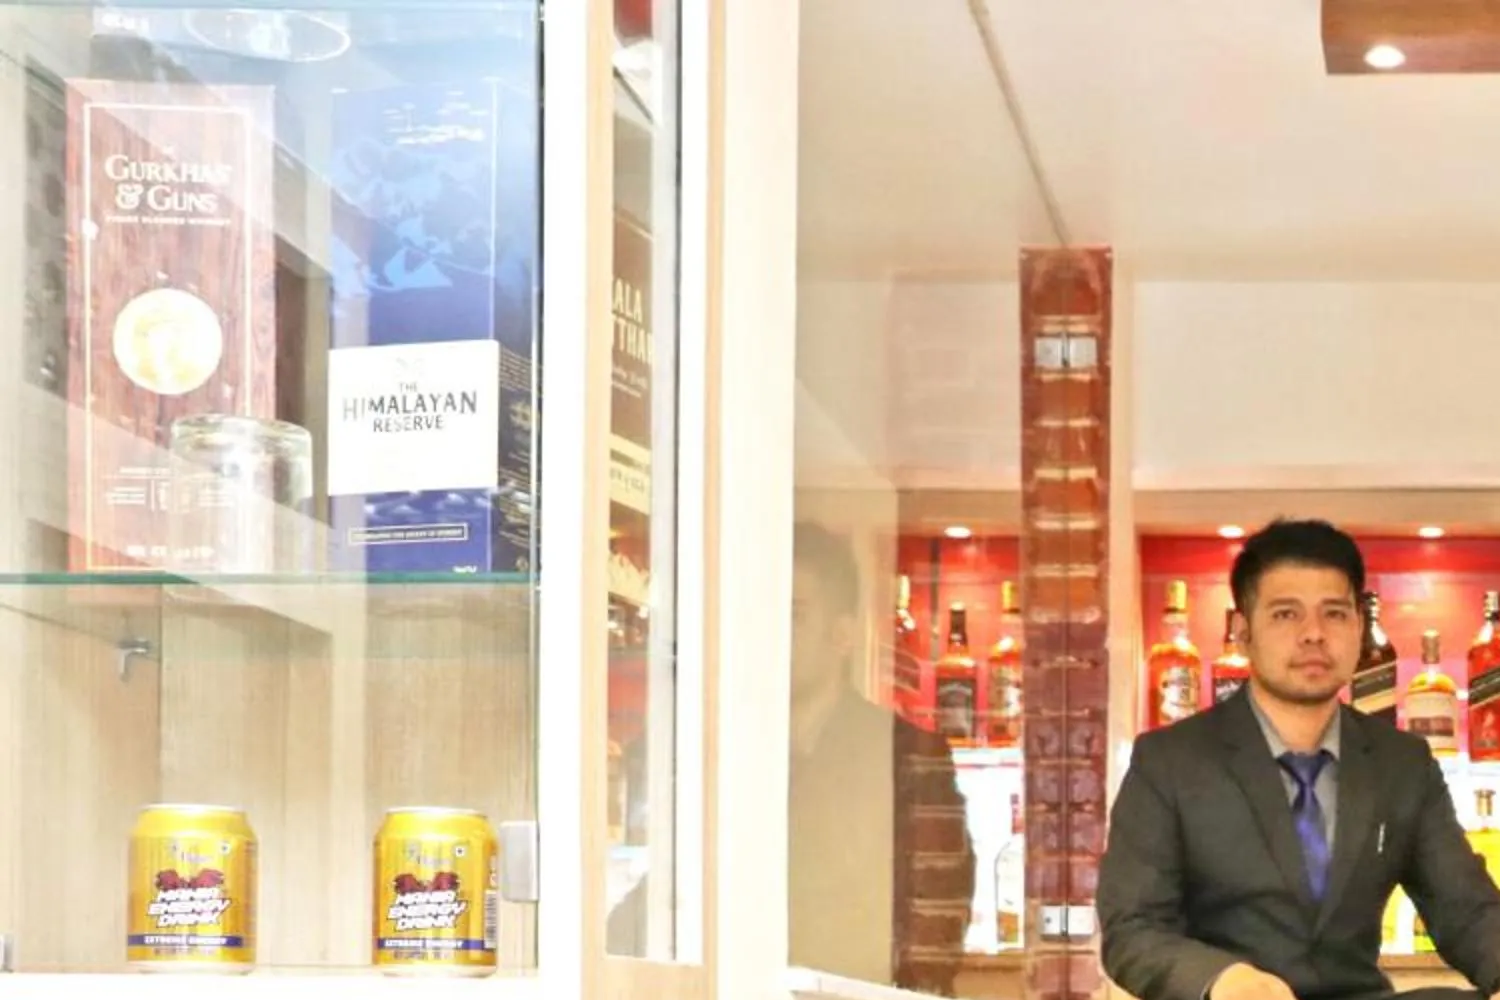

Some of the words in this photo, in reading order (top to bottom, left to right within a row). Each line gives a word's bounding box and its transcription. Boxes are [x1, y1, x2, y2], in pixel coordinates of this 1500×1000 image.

[115, 183, 144, 210] &
[147, 184, 219, 213] GUNS
[399, 381, 418, 393] THE
[342, 390, 478, 422] HIMALAYAN
[373, 414, 445, 433] RESERVE
